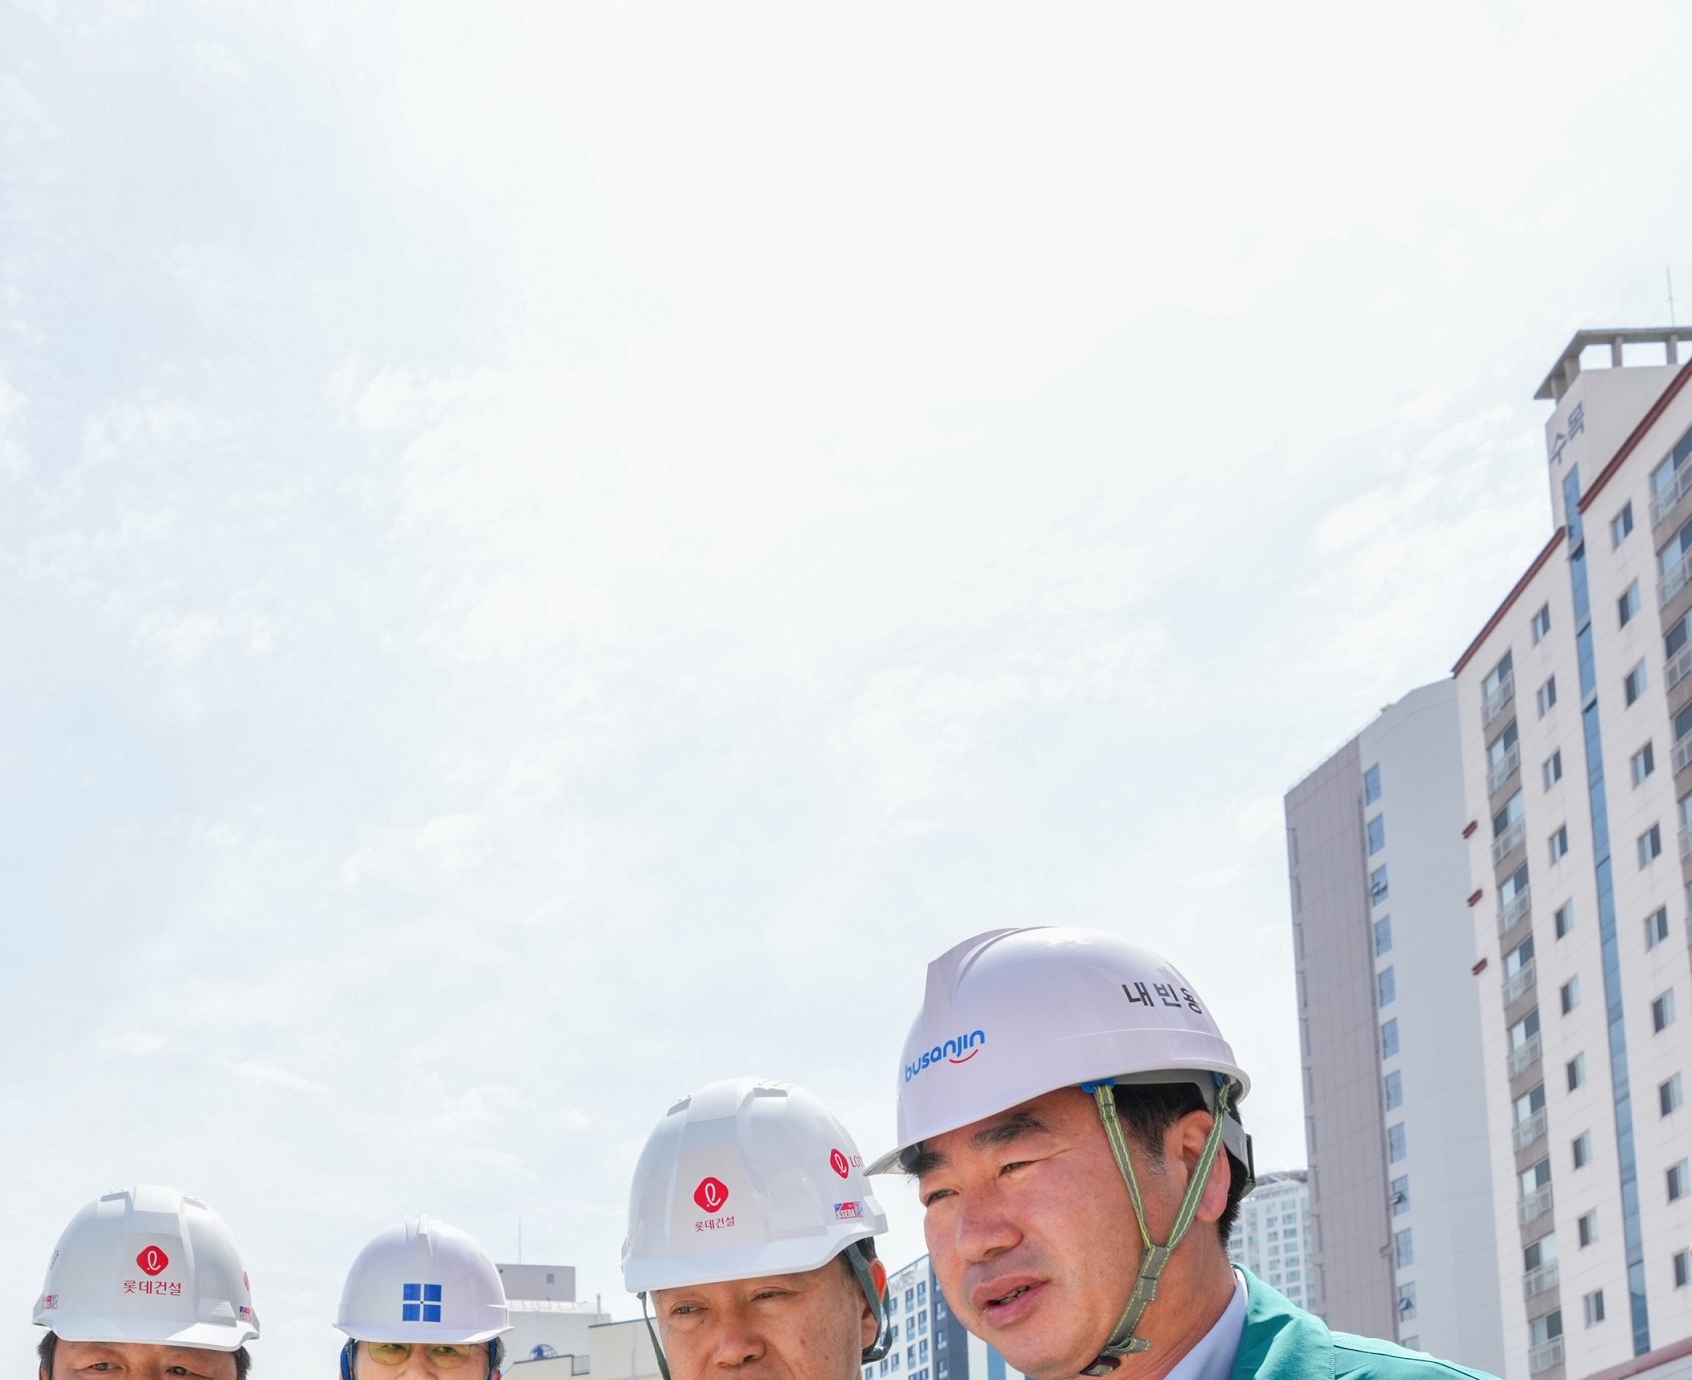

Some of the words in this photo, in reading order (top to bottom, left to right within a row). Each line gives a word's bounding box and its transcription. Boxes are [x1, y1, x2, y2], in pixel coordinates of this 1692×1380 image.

[1121, 981, 1203, 1015] 내빈용
[905, 1030, 985, 1082] busanjin
[694, 1215, 736, 1232] 롯데건설
[123, 1279, 182, 1296] 롯데건설
